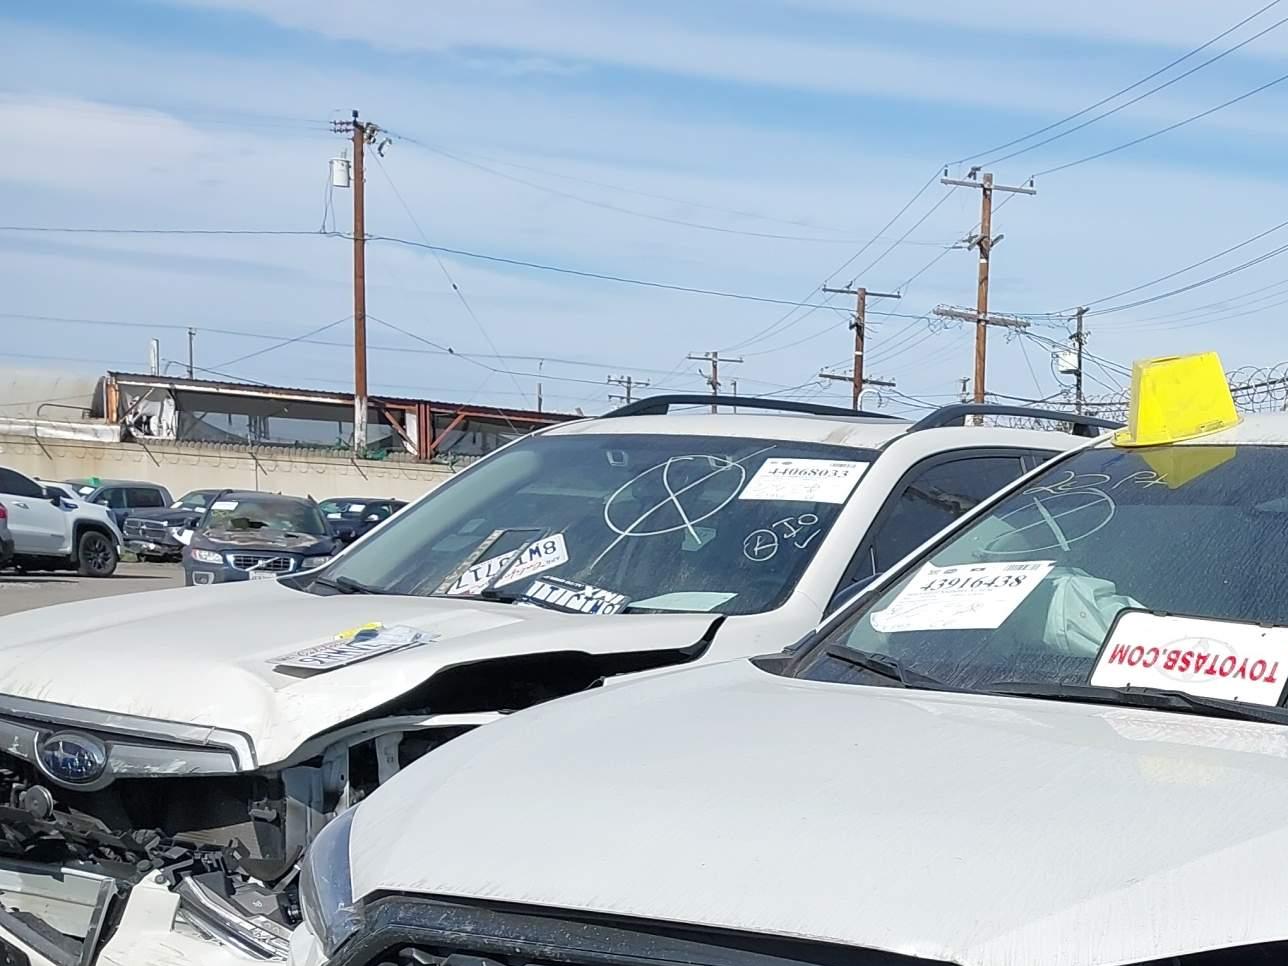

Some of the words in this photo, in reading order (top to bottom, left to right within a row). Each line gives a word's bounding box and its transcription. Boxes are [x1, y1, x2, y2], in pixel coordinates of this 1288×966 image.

[767, 467, 849, 478] 44068033
[920, 574, 1028, 592] 43916438
[1108, 643, 1280, 683] TOYOTASB.COM
